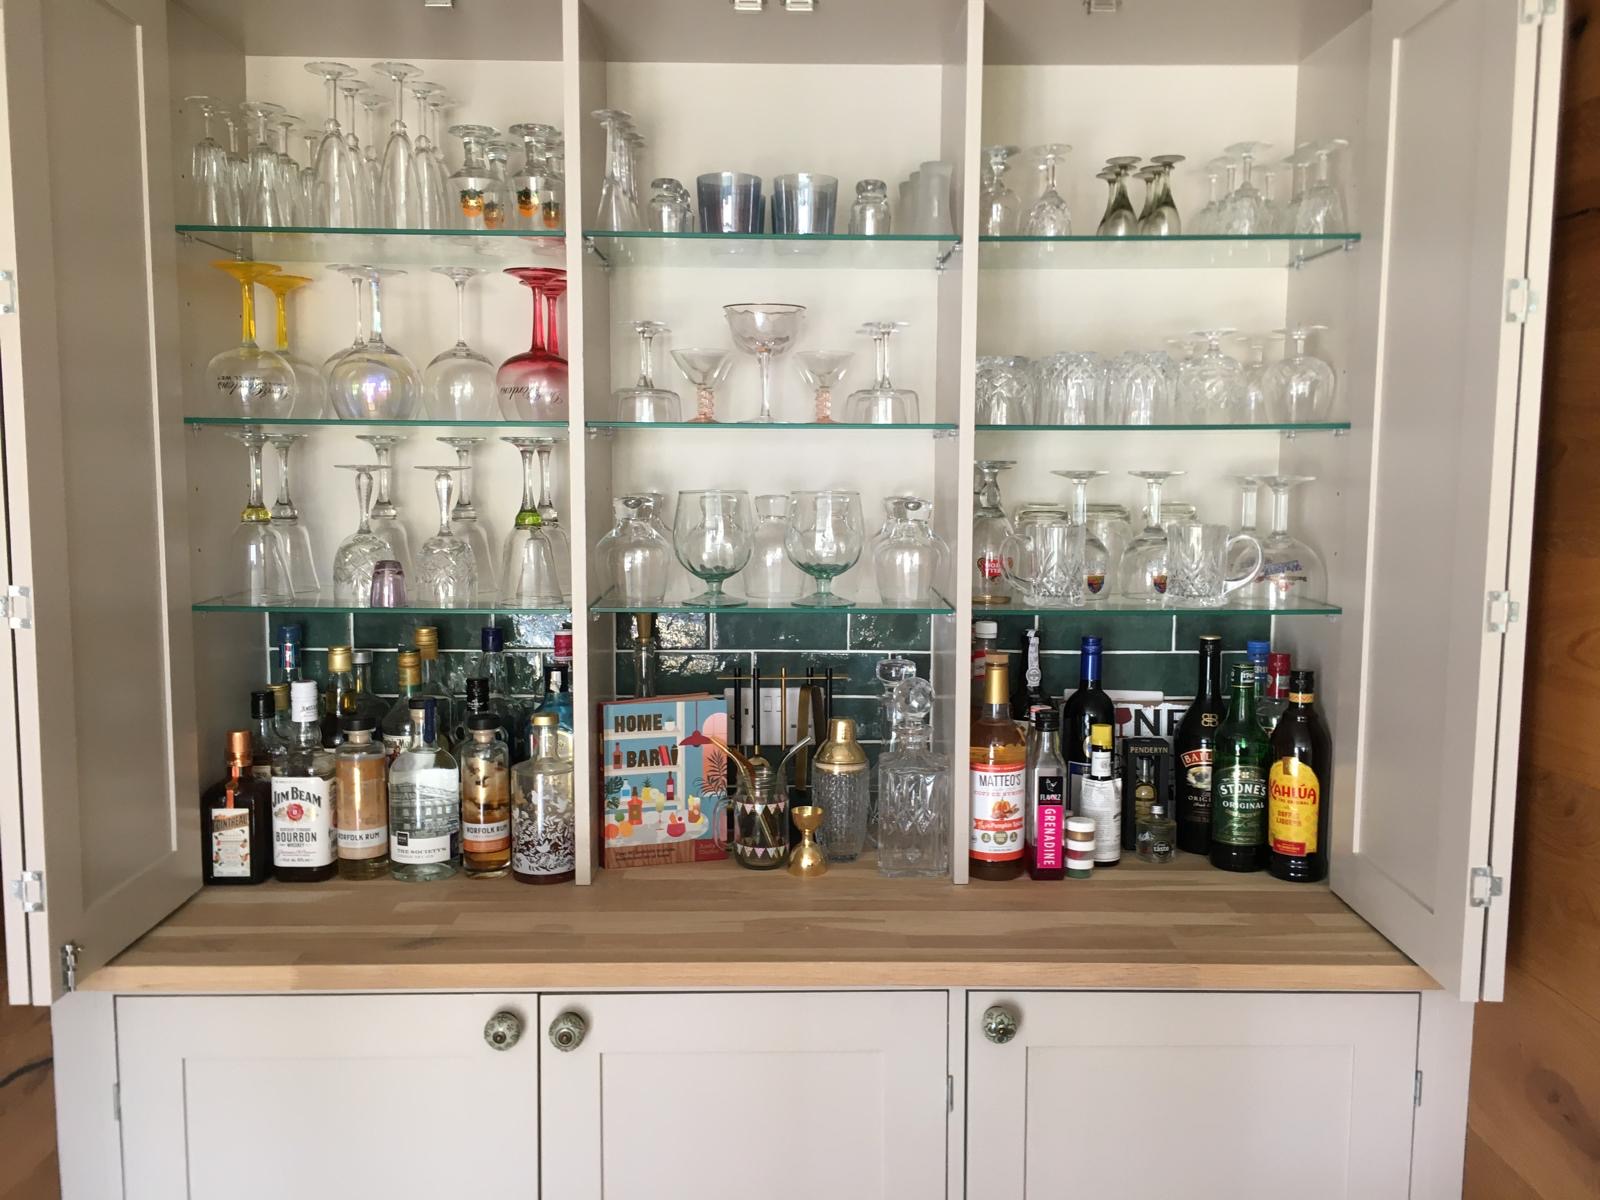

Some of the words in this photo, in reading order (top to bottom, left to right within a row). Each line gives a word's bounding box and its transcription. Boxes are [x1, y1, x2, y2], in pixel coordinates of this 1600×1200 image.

[614, 713, 663, 733] HOME
[1129, 746, 1169, 754] PENDERYN
[626, 749, 660, 768] BAR
[1183, 752, 1213, 769] BAIL
[978, 774, 1021, 787] MATTEO'S
[272, 790, 290, 808] JIM
[290, 786, 322, 808] BEAM
[1219, 784, 1266, 797] STONE'S
[1269, 777, 1317, 805] KAHLÚA
[1188, 795, 1211, 803] ORIGI
[1222, 800, 1265, 810] ORIGINAL
[275, 831, 318, 842] BOURBON
[365, 832, 380, 840] RUM
[1043, 808, 1056, 865] GRENADINE
